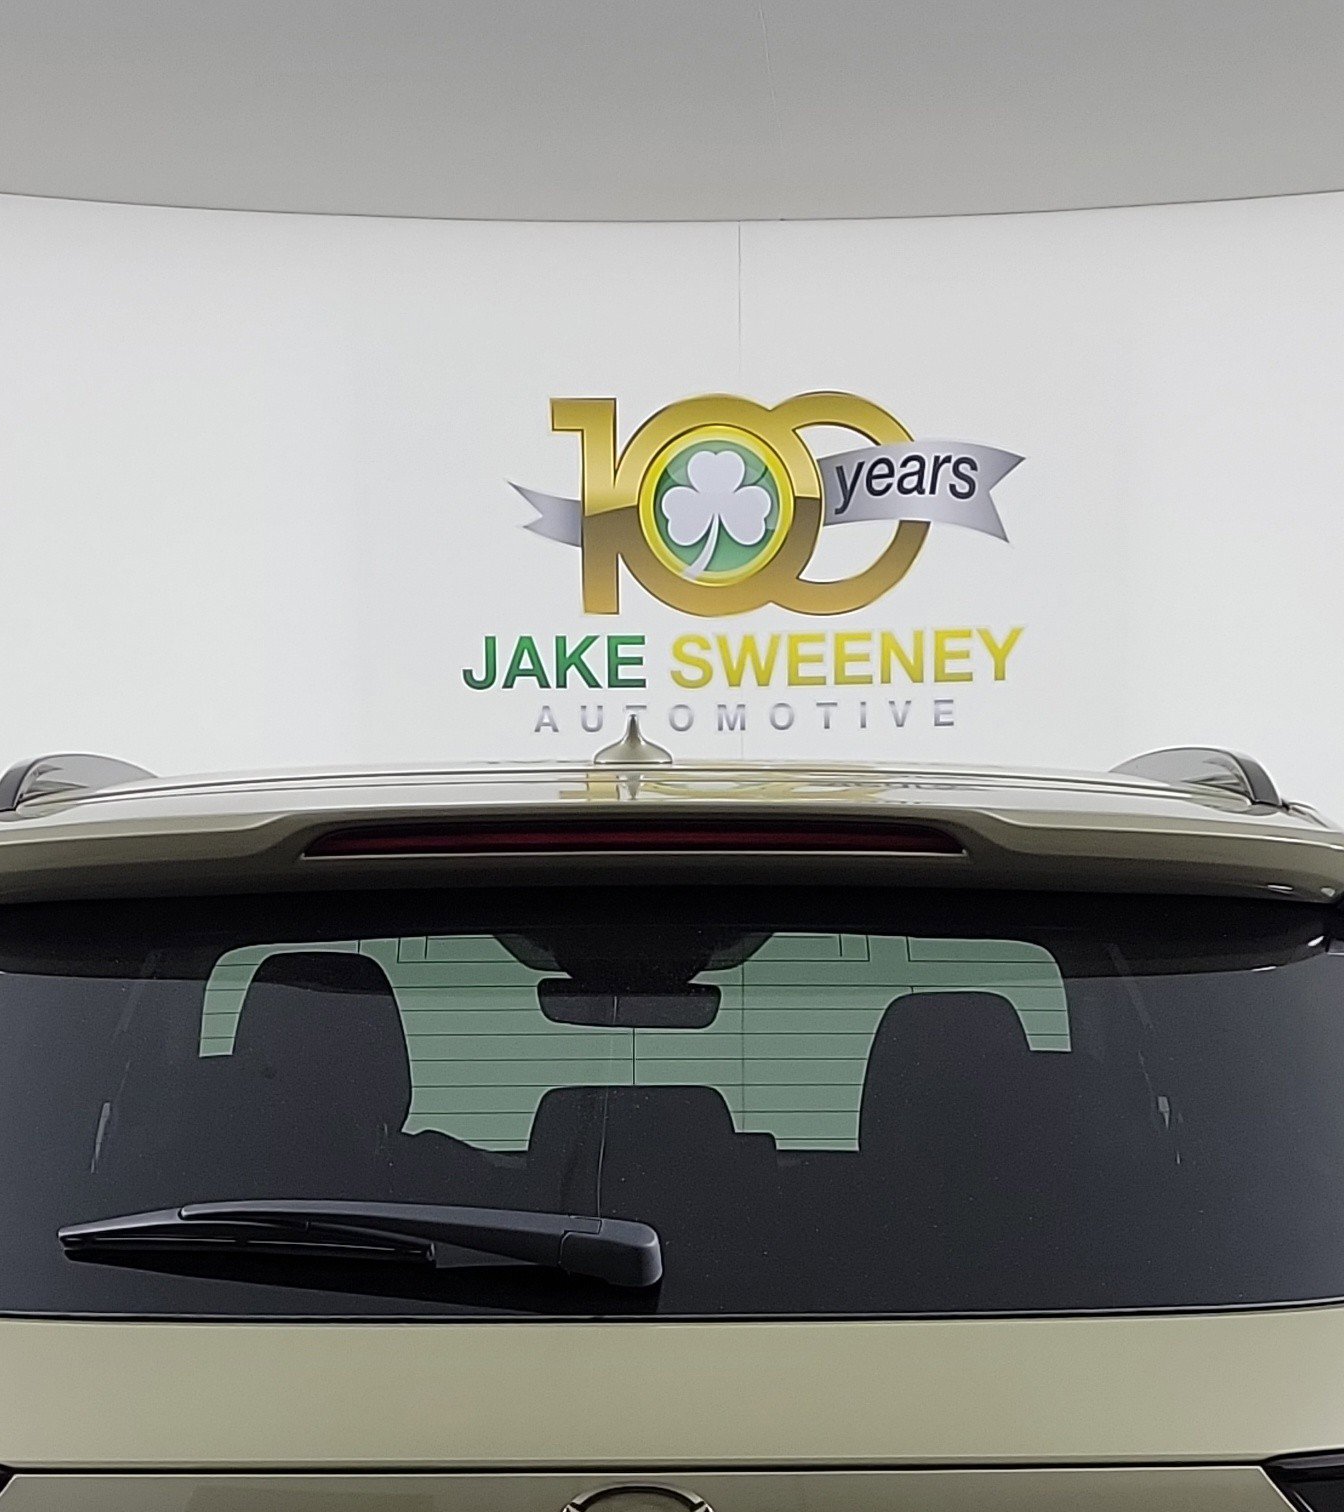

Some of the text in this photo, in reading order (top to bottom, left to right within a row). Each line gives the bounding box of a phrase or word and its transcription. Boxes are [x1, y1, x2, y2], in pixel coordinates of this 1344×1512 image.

[549, 390, 978, 617] 100 years
[462, 627, 1025, 690] JAKE SWEENEY
